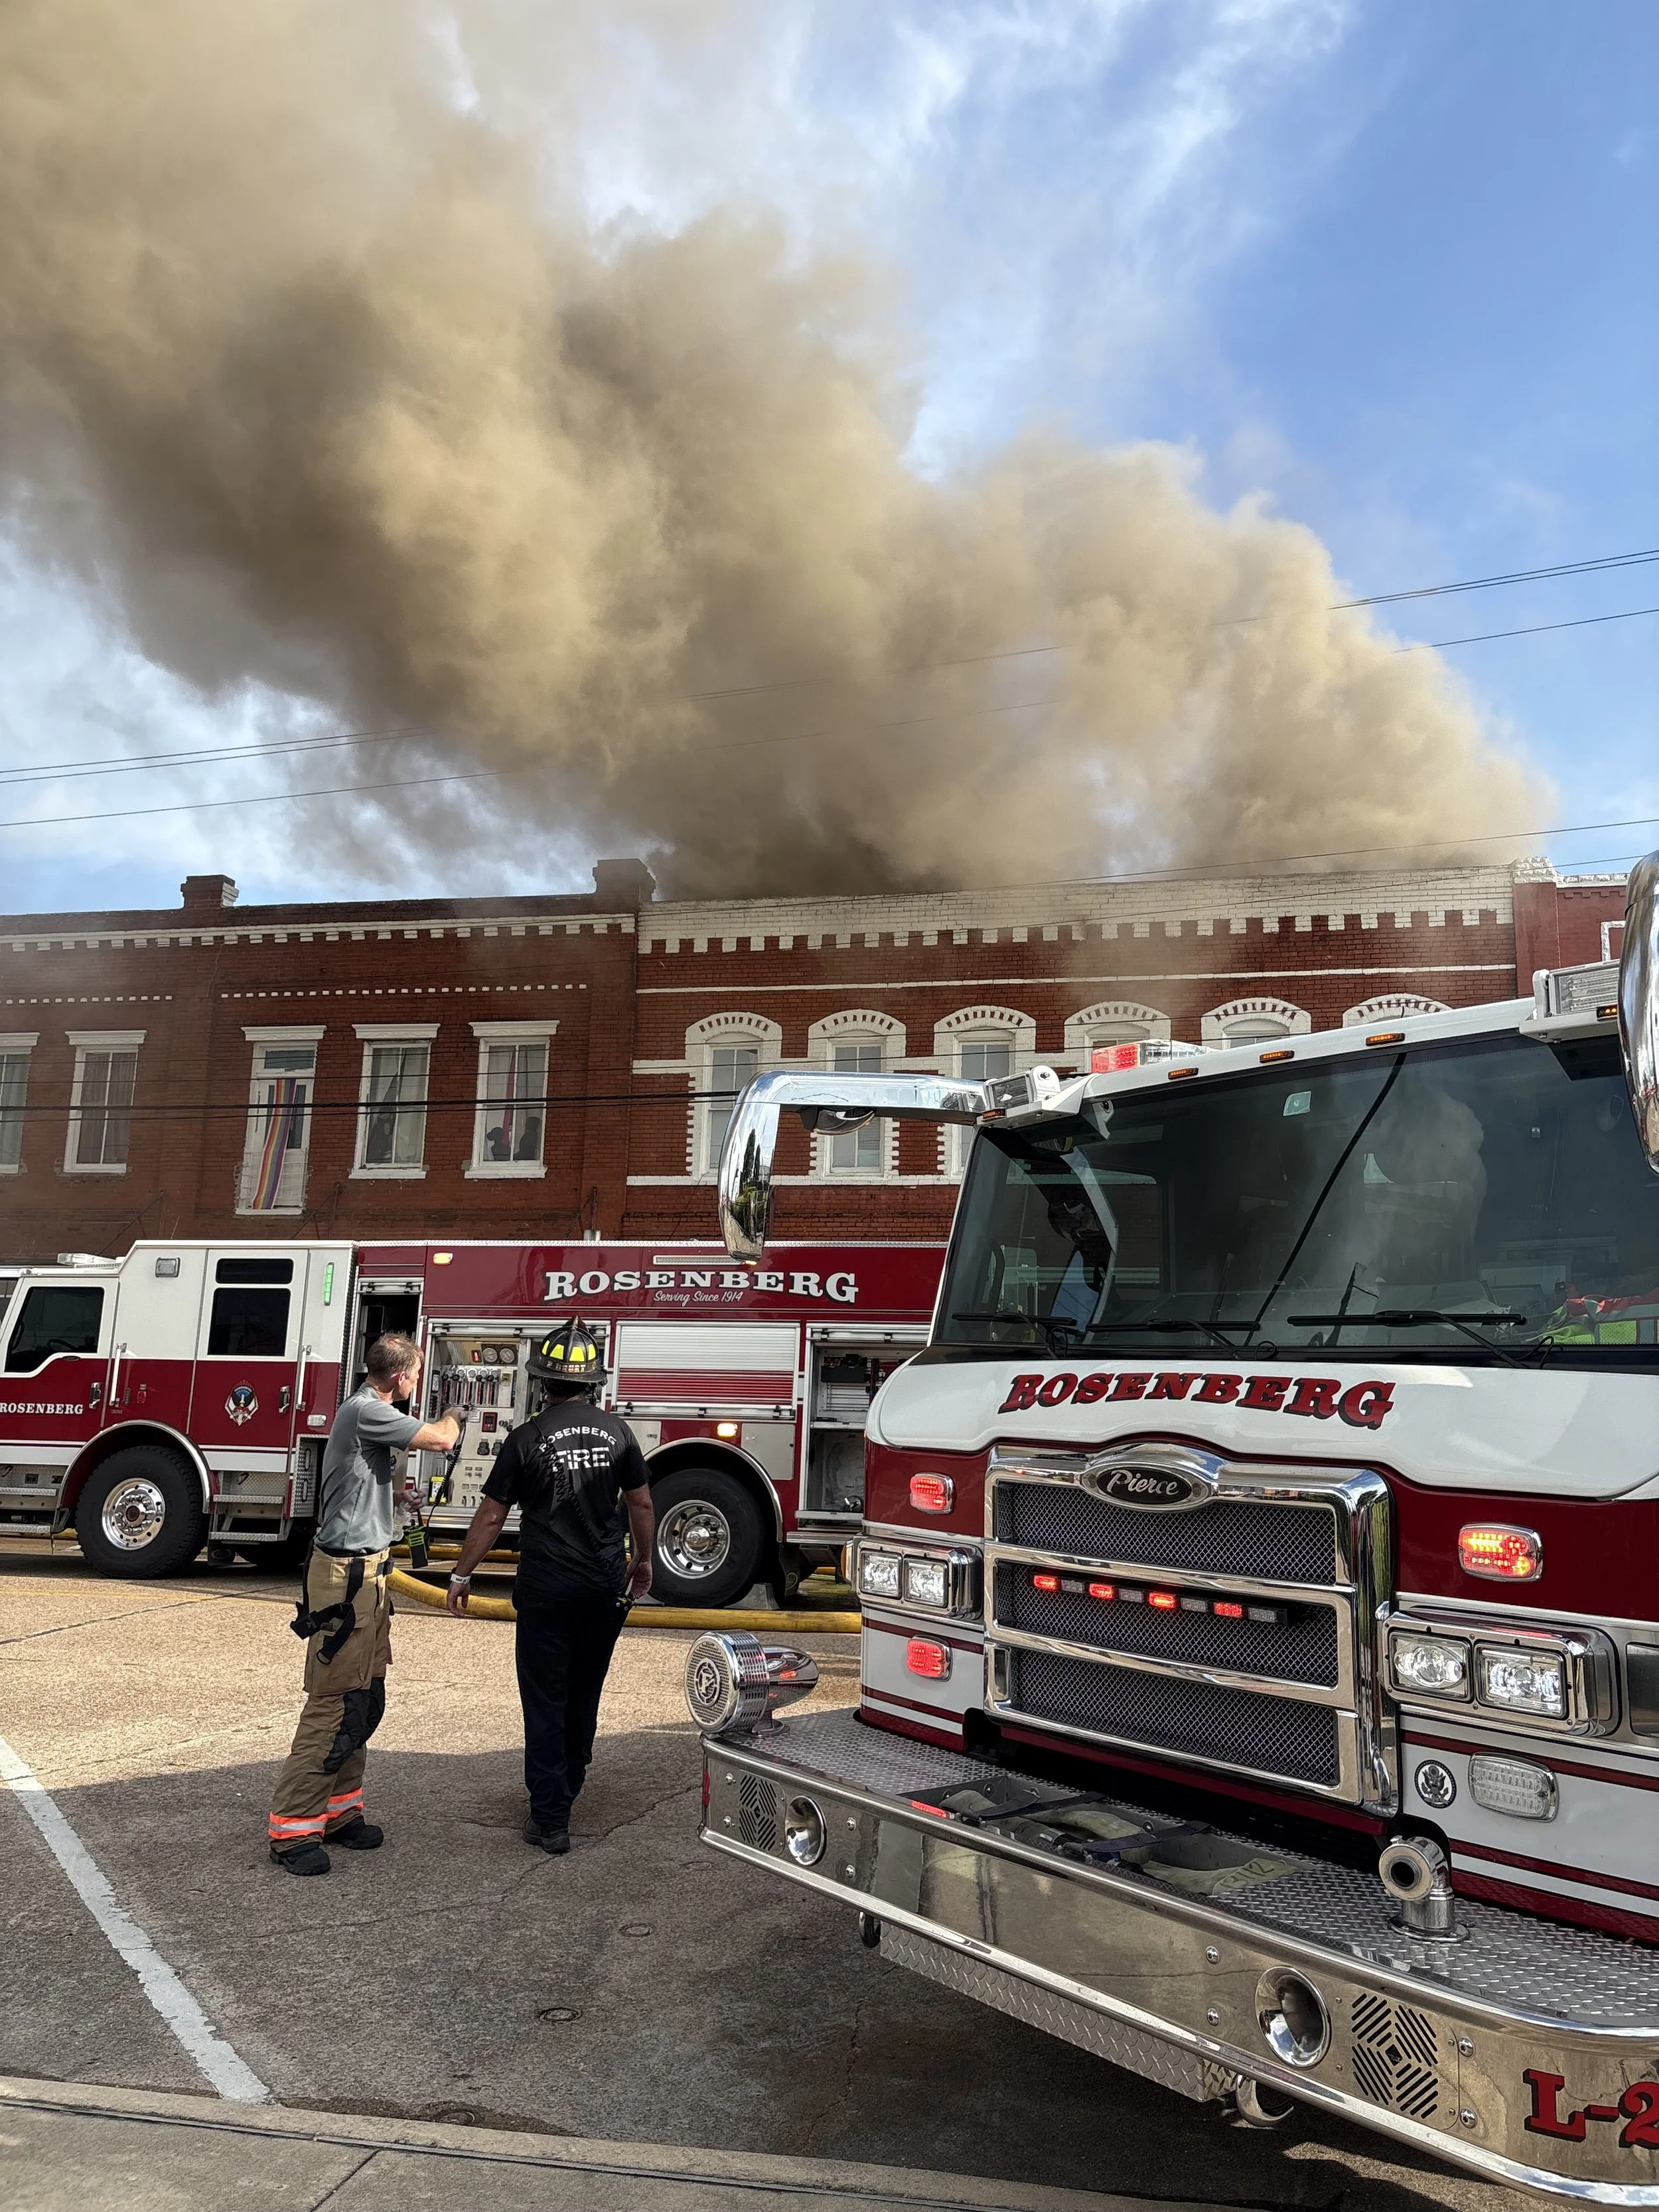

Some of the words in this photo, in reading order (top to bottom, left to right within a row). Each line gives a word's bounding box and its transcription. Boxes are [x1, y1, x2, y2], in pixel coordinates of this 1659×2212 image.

[543, 1270, 859, 1303] ROSENBERG
[653, 1290, 691, 1307] Serving
[692, 1290, 719, 1301] Since
[721, 1291, 743, 1302] 1914
[0, 1402, 84, 1415] ROSENBERG
[997, 1372, 1396, 1430] ROSENBERG
[538, 1426, 617, 1453] ROSENBERG
[1106, 1469, 1179, 1496] Pierce
